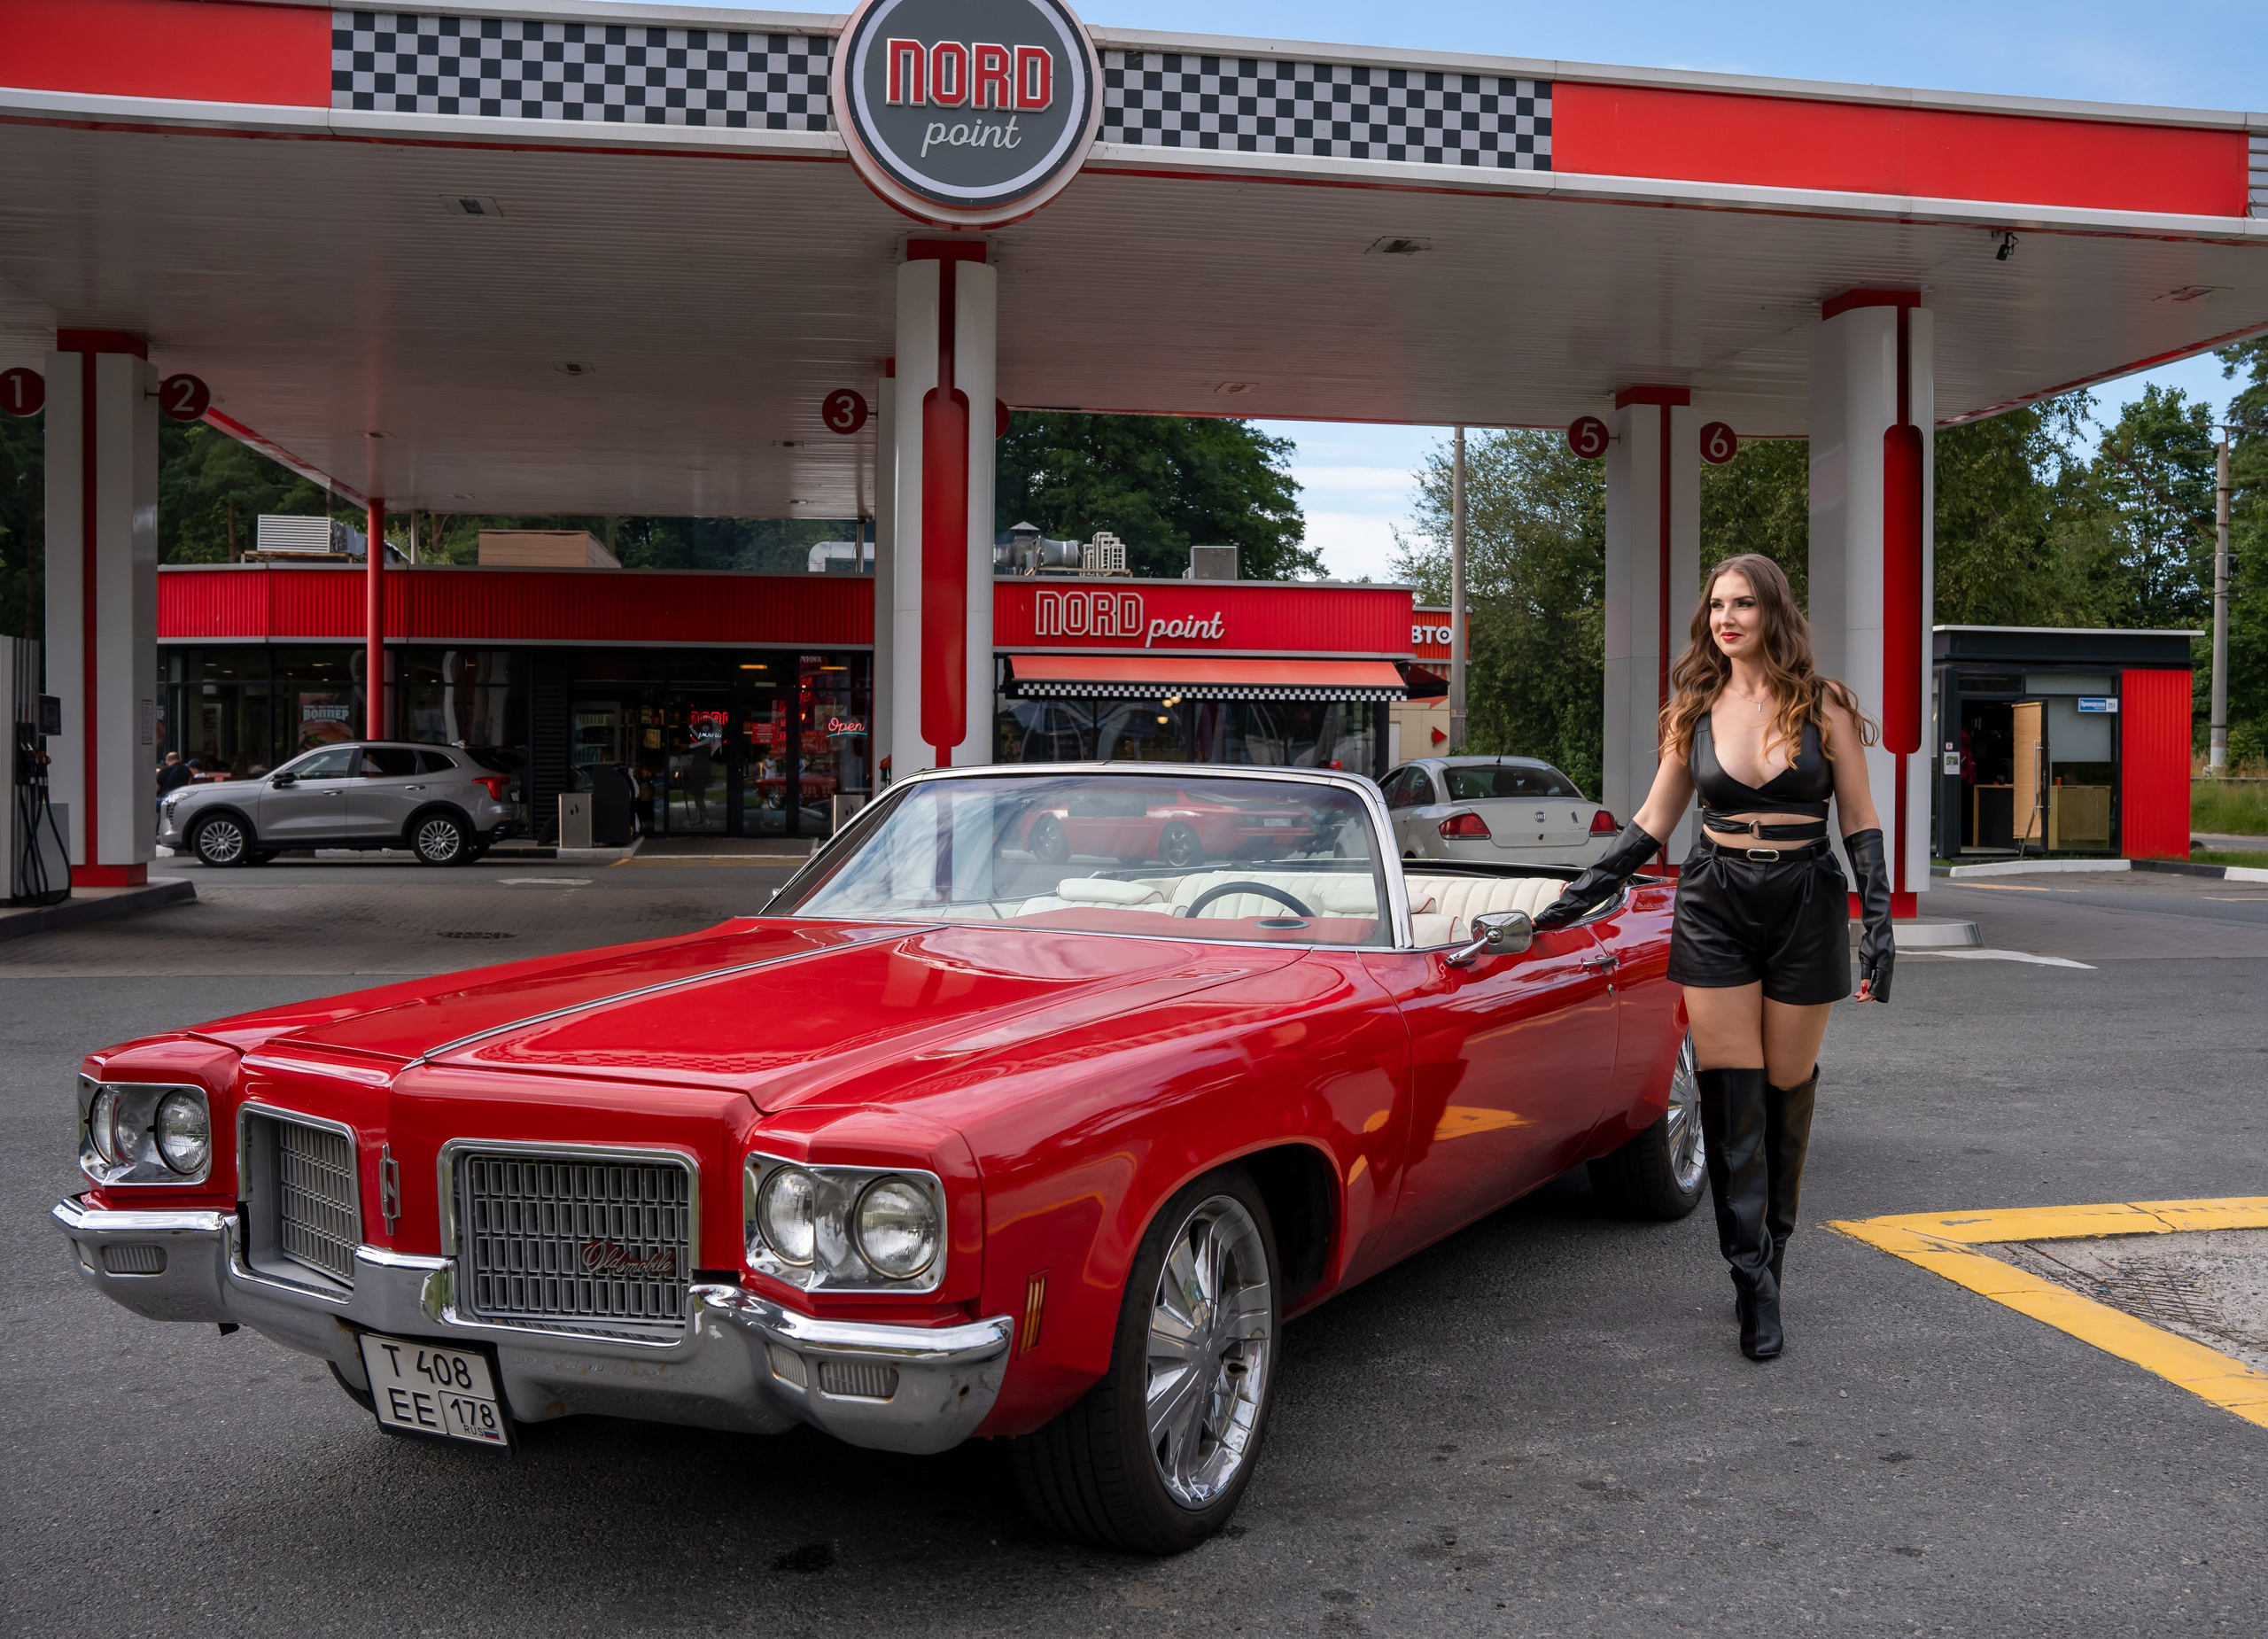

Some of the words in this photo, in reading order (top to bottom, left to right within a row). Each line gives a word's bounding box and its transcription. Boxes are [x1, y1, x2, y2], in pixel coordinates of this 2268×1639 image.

[886, 38, 1053, 113] NORD
[920, 115, 1021, 159] point
[9, 375, 23, 408] 1
[171, 378, 195, 412] 2
[833, 395, 855, 428] 3
[1580, 423, 1599, 453] 5
[1709, 427, 1728, 458] 6
[1035, 591, 1144, 637] NORD
[1145, 611, 1225, 648] point
[303, 709, 349, 721] ВОППЕР
[827, 717, 865, 735] Open
[582, 1241, 674, 1272] Oldsmobile
[381, 1342, 400, 1378] T
[416, 1350, 472, 1389] 408
[387, 1387, 438, 1427] EE
[450, 1397, 495, 1428] 178
[463, 1425, 484, 1437] RUS
